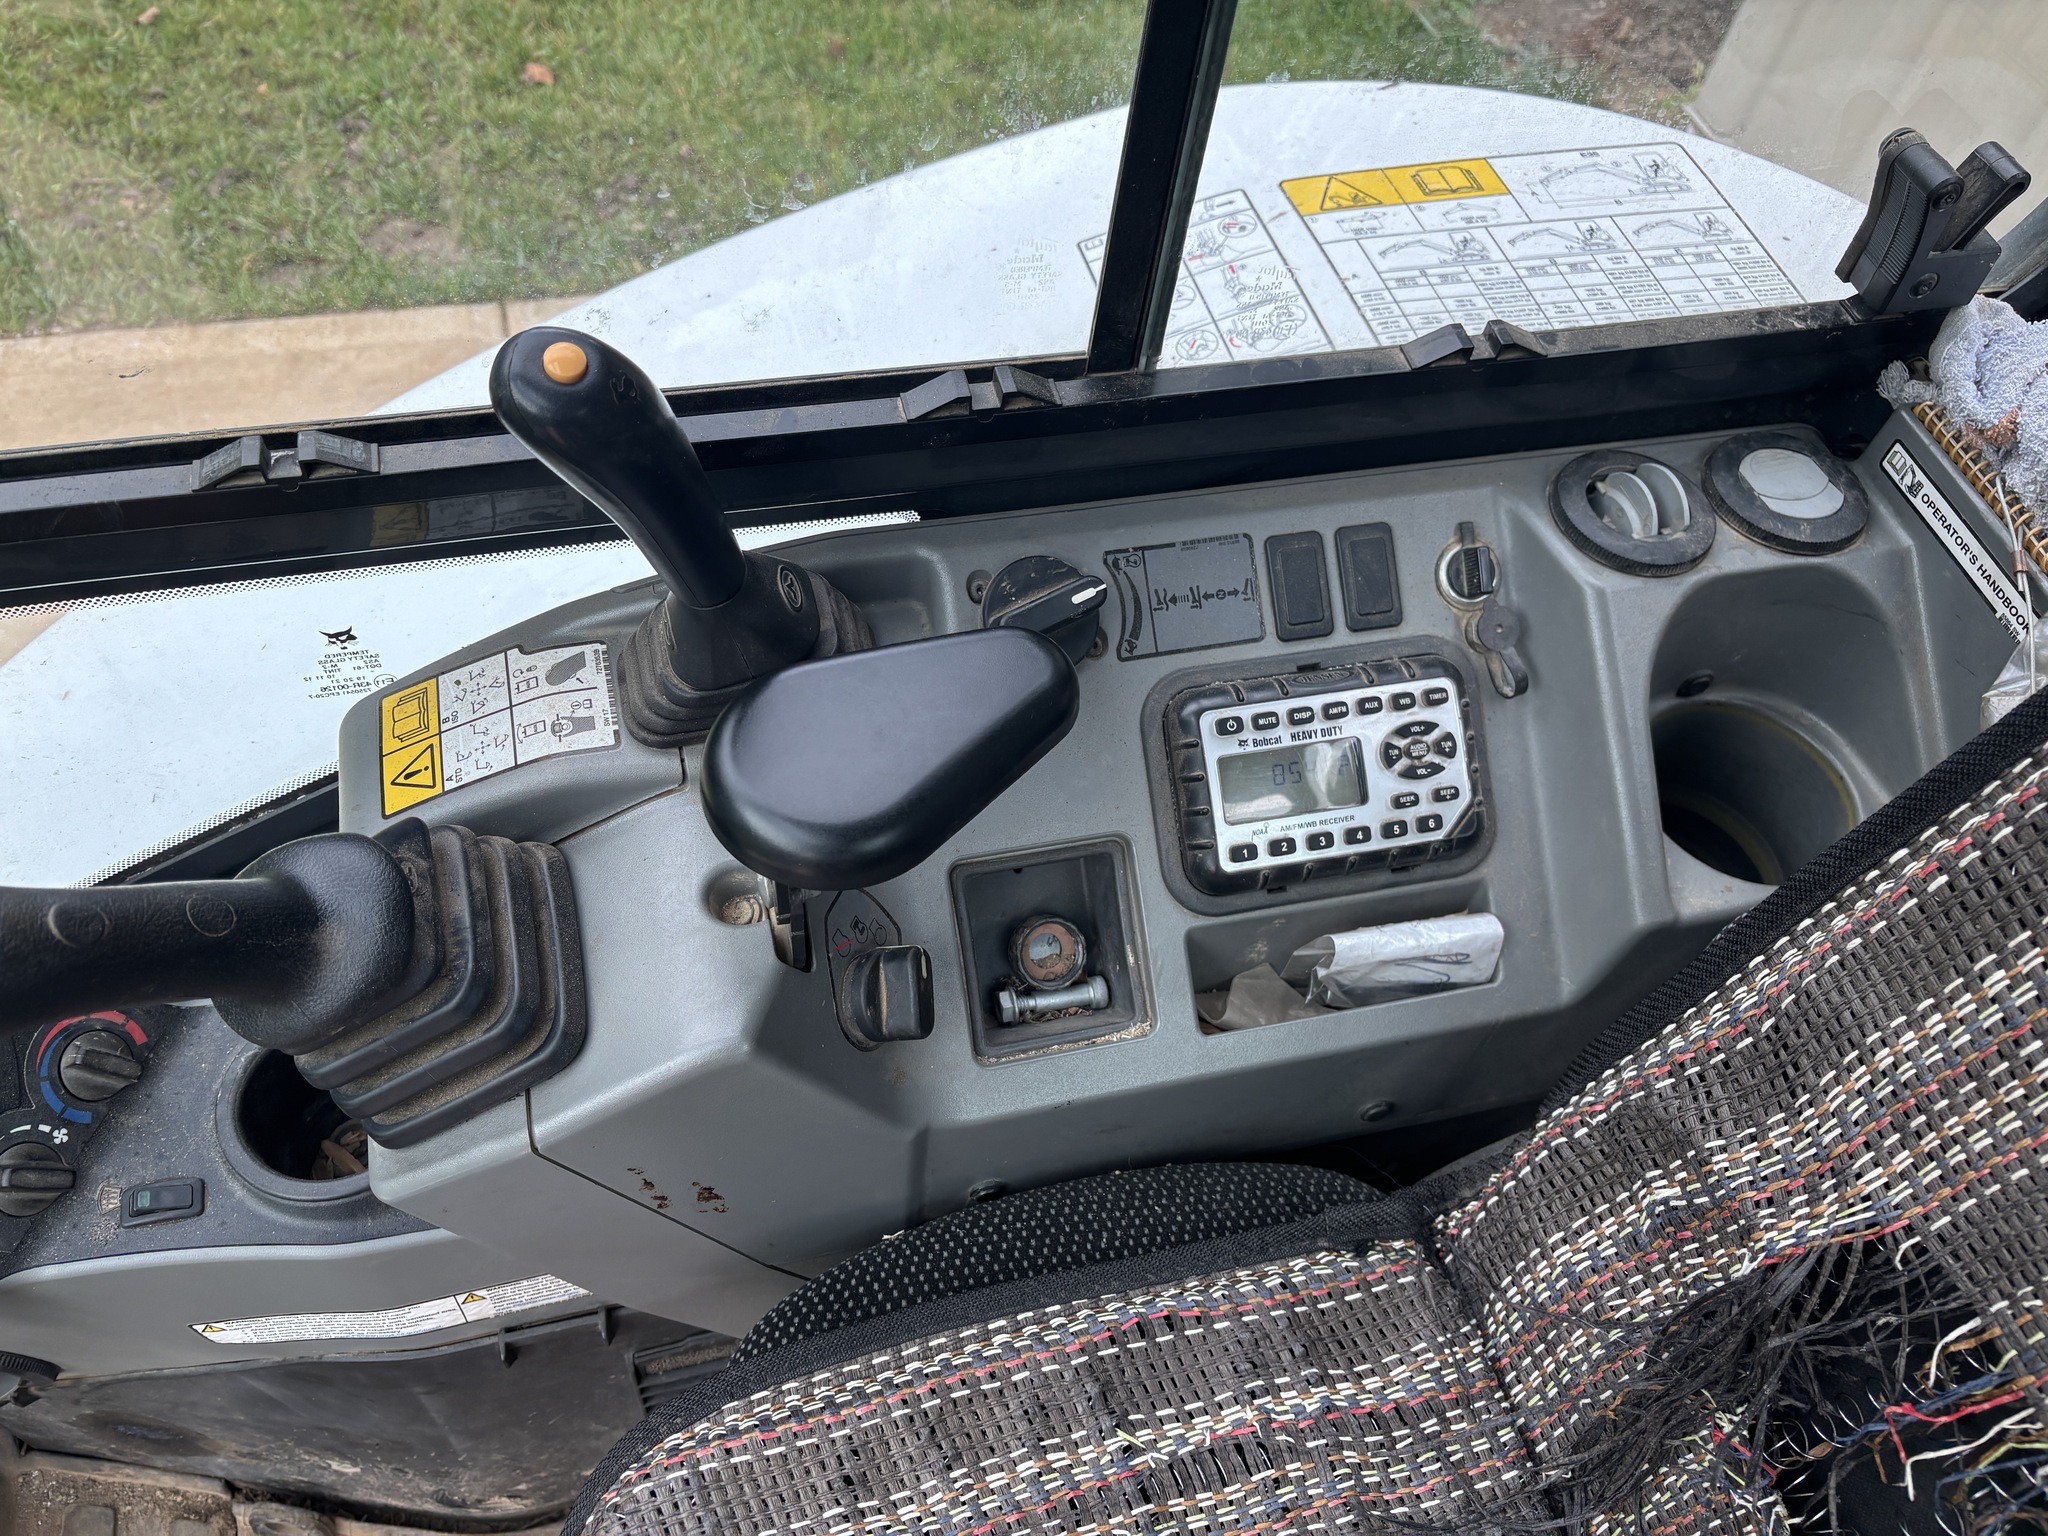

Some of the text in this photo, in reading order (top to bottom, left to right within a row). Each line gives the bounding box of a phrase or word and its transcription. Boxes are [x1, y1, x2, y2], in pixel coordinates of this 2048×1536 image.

[1921, 494, 2030, 637] OPERATOR'S HANDBOOK
[1429, 691, 1447, 701] TIMER
[1364, 700, 1378, 709] AUX
[1399, 697, 1411, 706] WB
[1328, 705, 1347, 714] AM/FM
[450, 710, 459, 725] ISO
[1294, 711, 1312, 721] DISP
[1258, 716, 1277, 726] MUTE
[1252, 726, 1343, 748] Bobcat HEAVY DUTY
[1440, 740, 1452, 749] TUN
[1388, 749, 1399, 758] TUN
[454, 767, 463, 784] STD
[1440, 788, 1456, 796] SEEK
[1399, 795, 1416, 803] SEEK
[1319, 814, 1355, 828] RECEIVER
[1428, 819, 1434, 828] 6
[1393, 825, 1400, 834] 5
[1356, 831, 1363, 840] 4
[1320, 837, 1326, 846] 3
[1281, 842, 1288, 852] 2
[1242, 849, 1248, 858] 1
